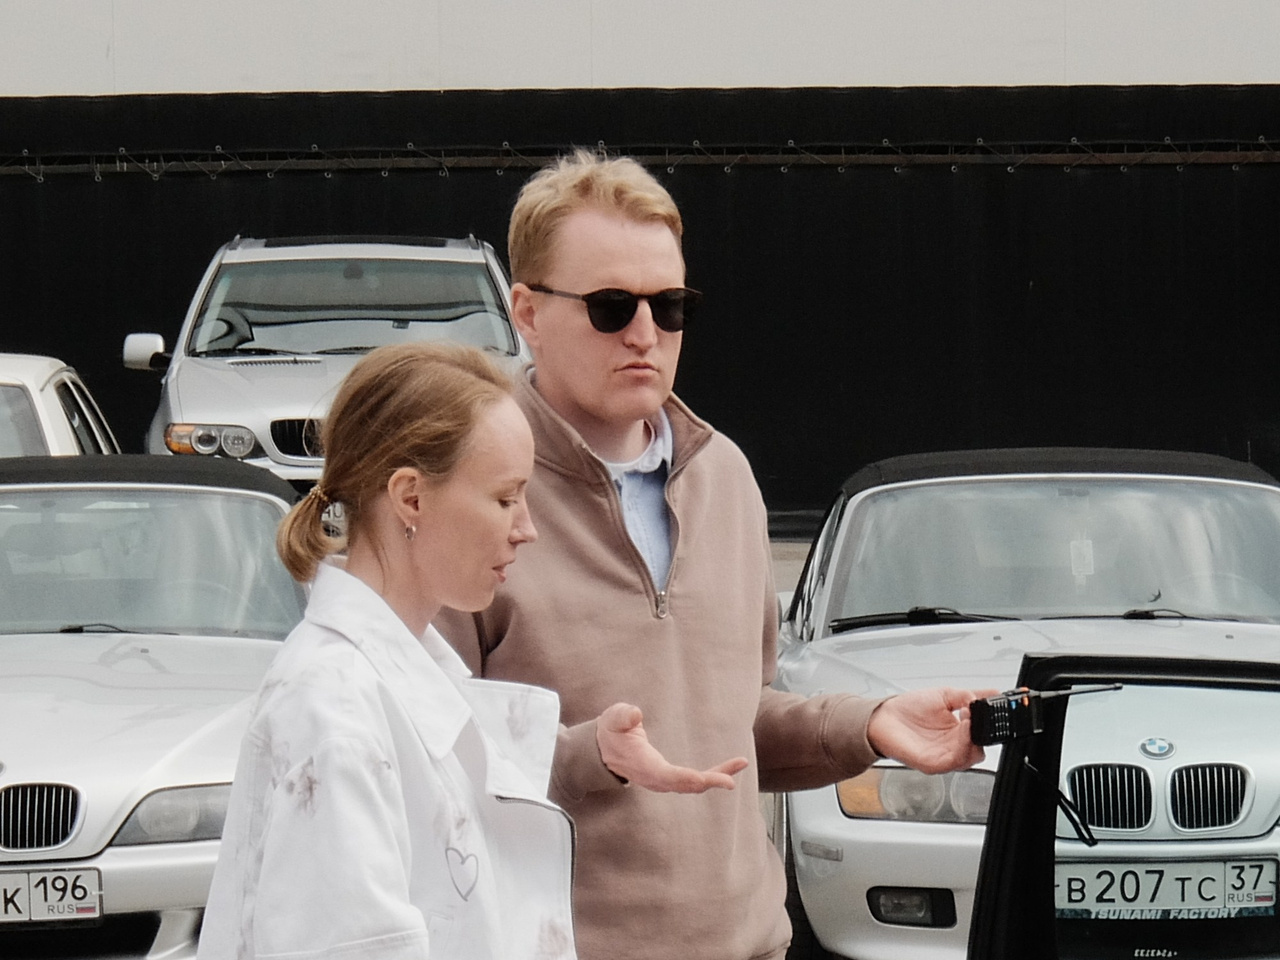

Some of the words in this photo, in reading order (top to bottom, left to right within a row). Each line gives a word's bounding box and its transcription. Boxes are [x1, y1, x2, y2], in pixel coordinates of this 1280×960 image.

[1067, 877, 1086, 903] B
[1095, 870, 1164, 903] 207
[1175, 877, 1216, 902] TC
[1231, 865, 1264, 890] 37
[34, 874, 88, 902] 196
[1227, 893, 1253, 903] RUS
[47, 904, 75, 914] RUS
[1090, 908, 1163, 920] TSUNAMI
[1169, 907, 1240, 919] FACTORY
